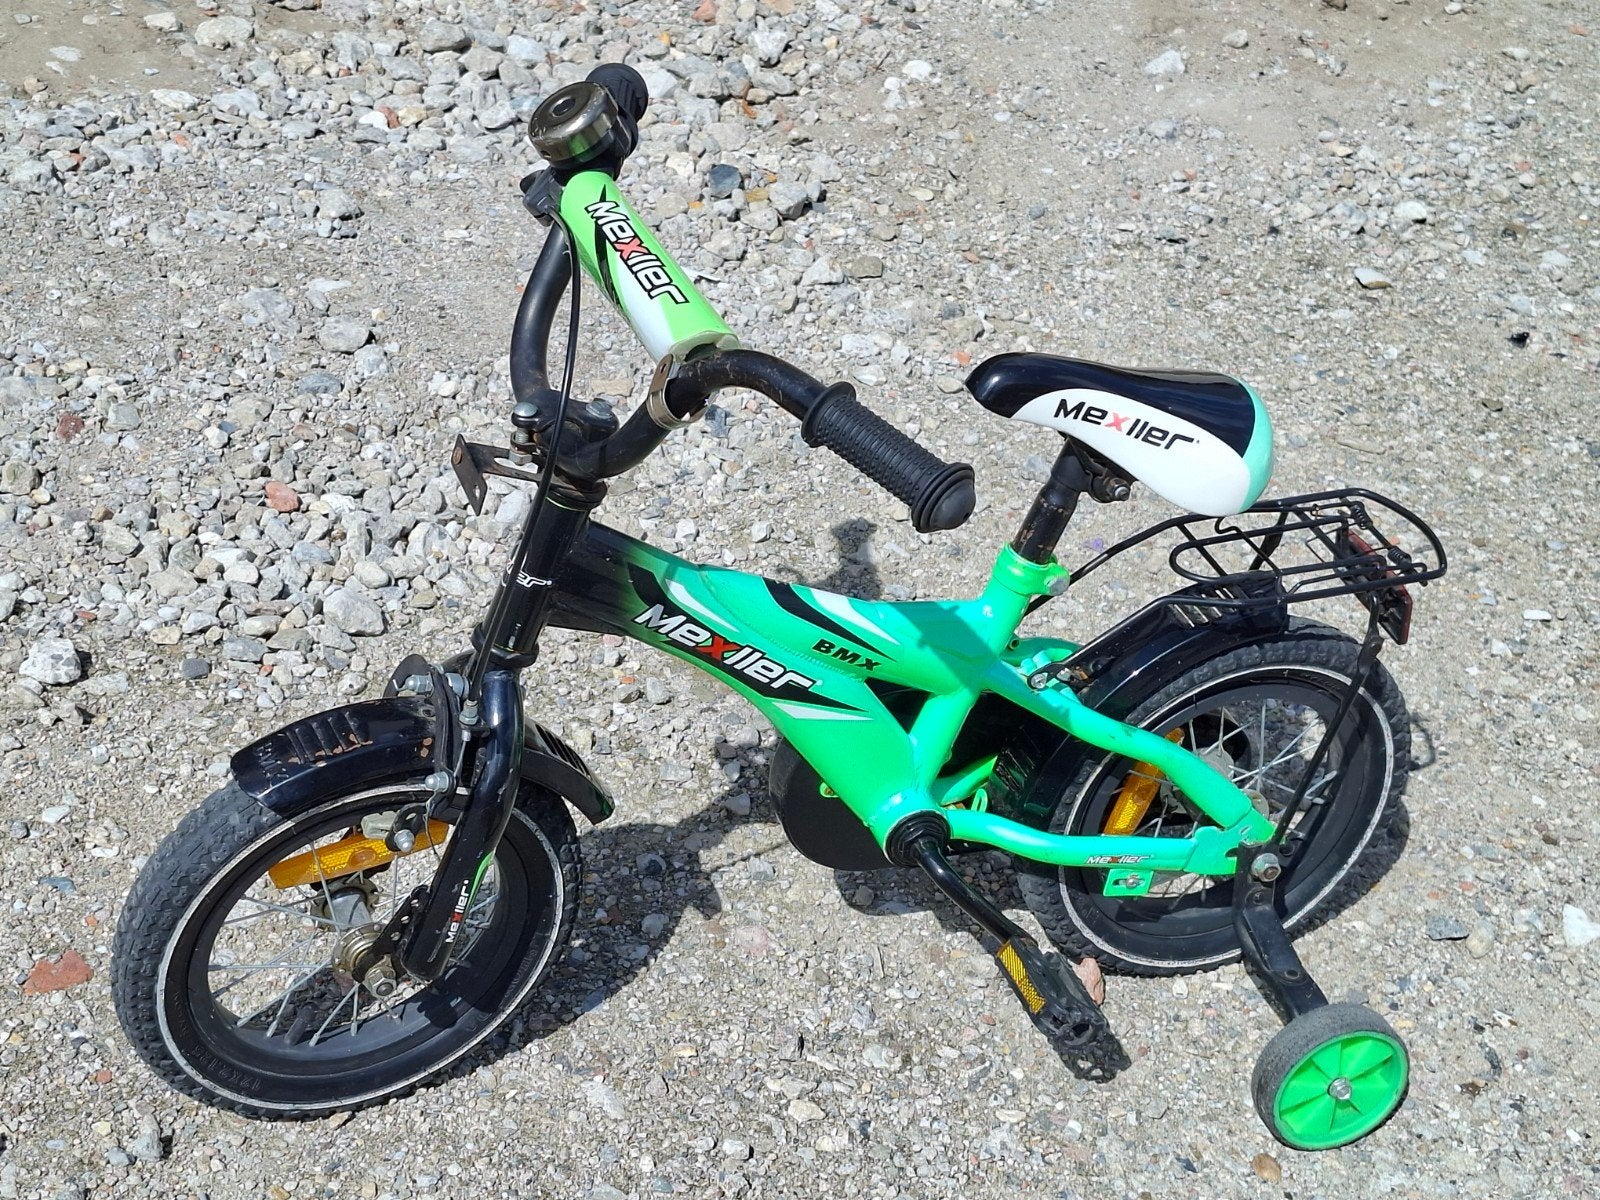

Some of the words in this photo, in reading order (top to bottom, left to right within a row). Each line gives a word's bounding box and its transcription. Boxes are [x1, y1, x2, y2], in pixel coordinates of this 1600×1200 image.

[584, 200, 690, 305] Mexller
[1053, 398, 1194, 450] Mexller
[632, 603, 817, 692] Mexller
[811, 638, 882, 672] BMX
[1085, 854, 1151, 865] Mexller
[445, 885, 470, 943] Mexller
